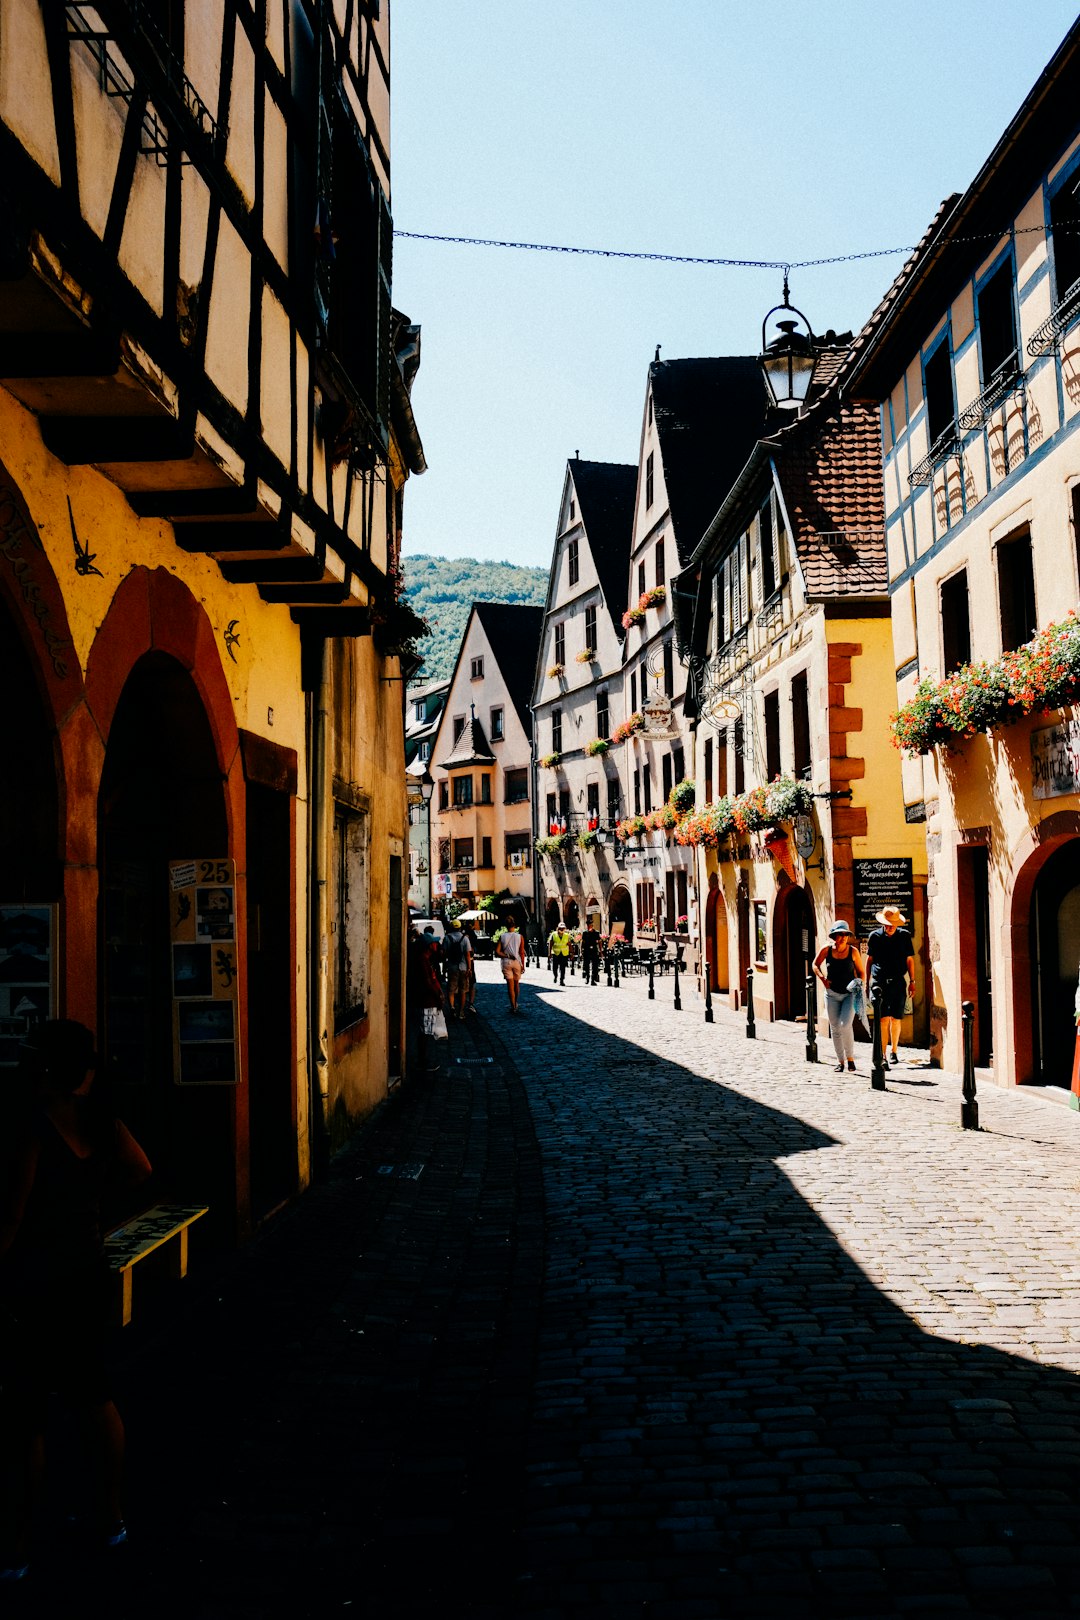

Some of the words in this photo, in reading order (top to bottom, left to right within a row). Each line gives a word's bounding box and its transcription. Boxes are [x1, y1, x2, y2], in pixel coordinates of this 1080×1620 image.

[1033, 755, 1056, 785] Pain
[202, 862, 229, 883] 25
[873, 862, 899, 871] Glacier
